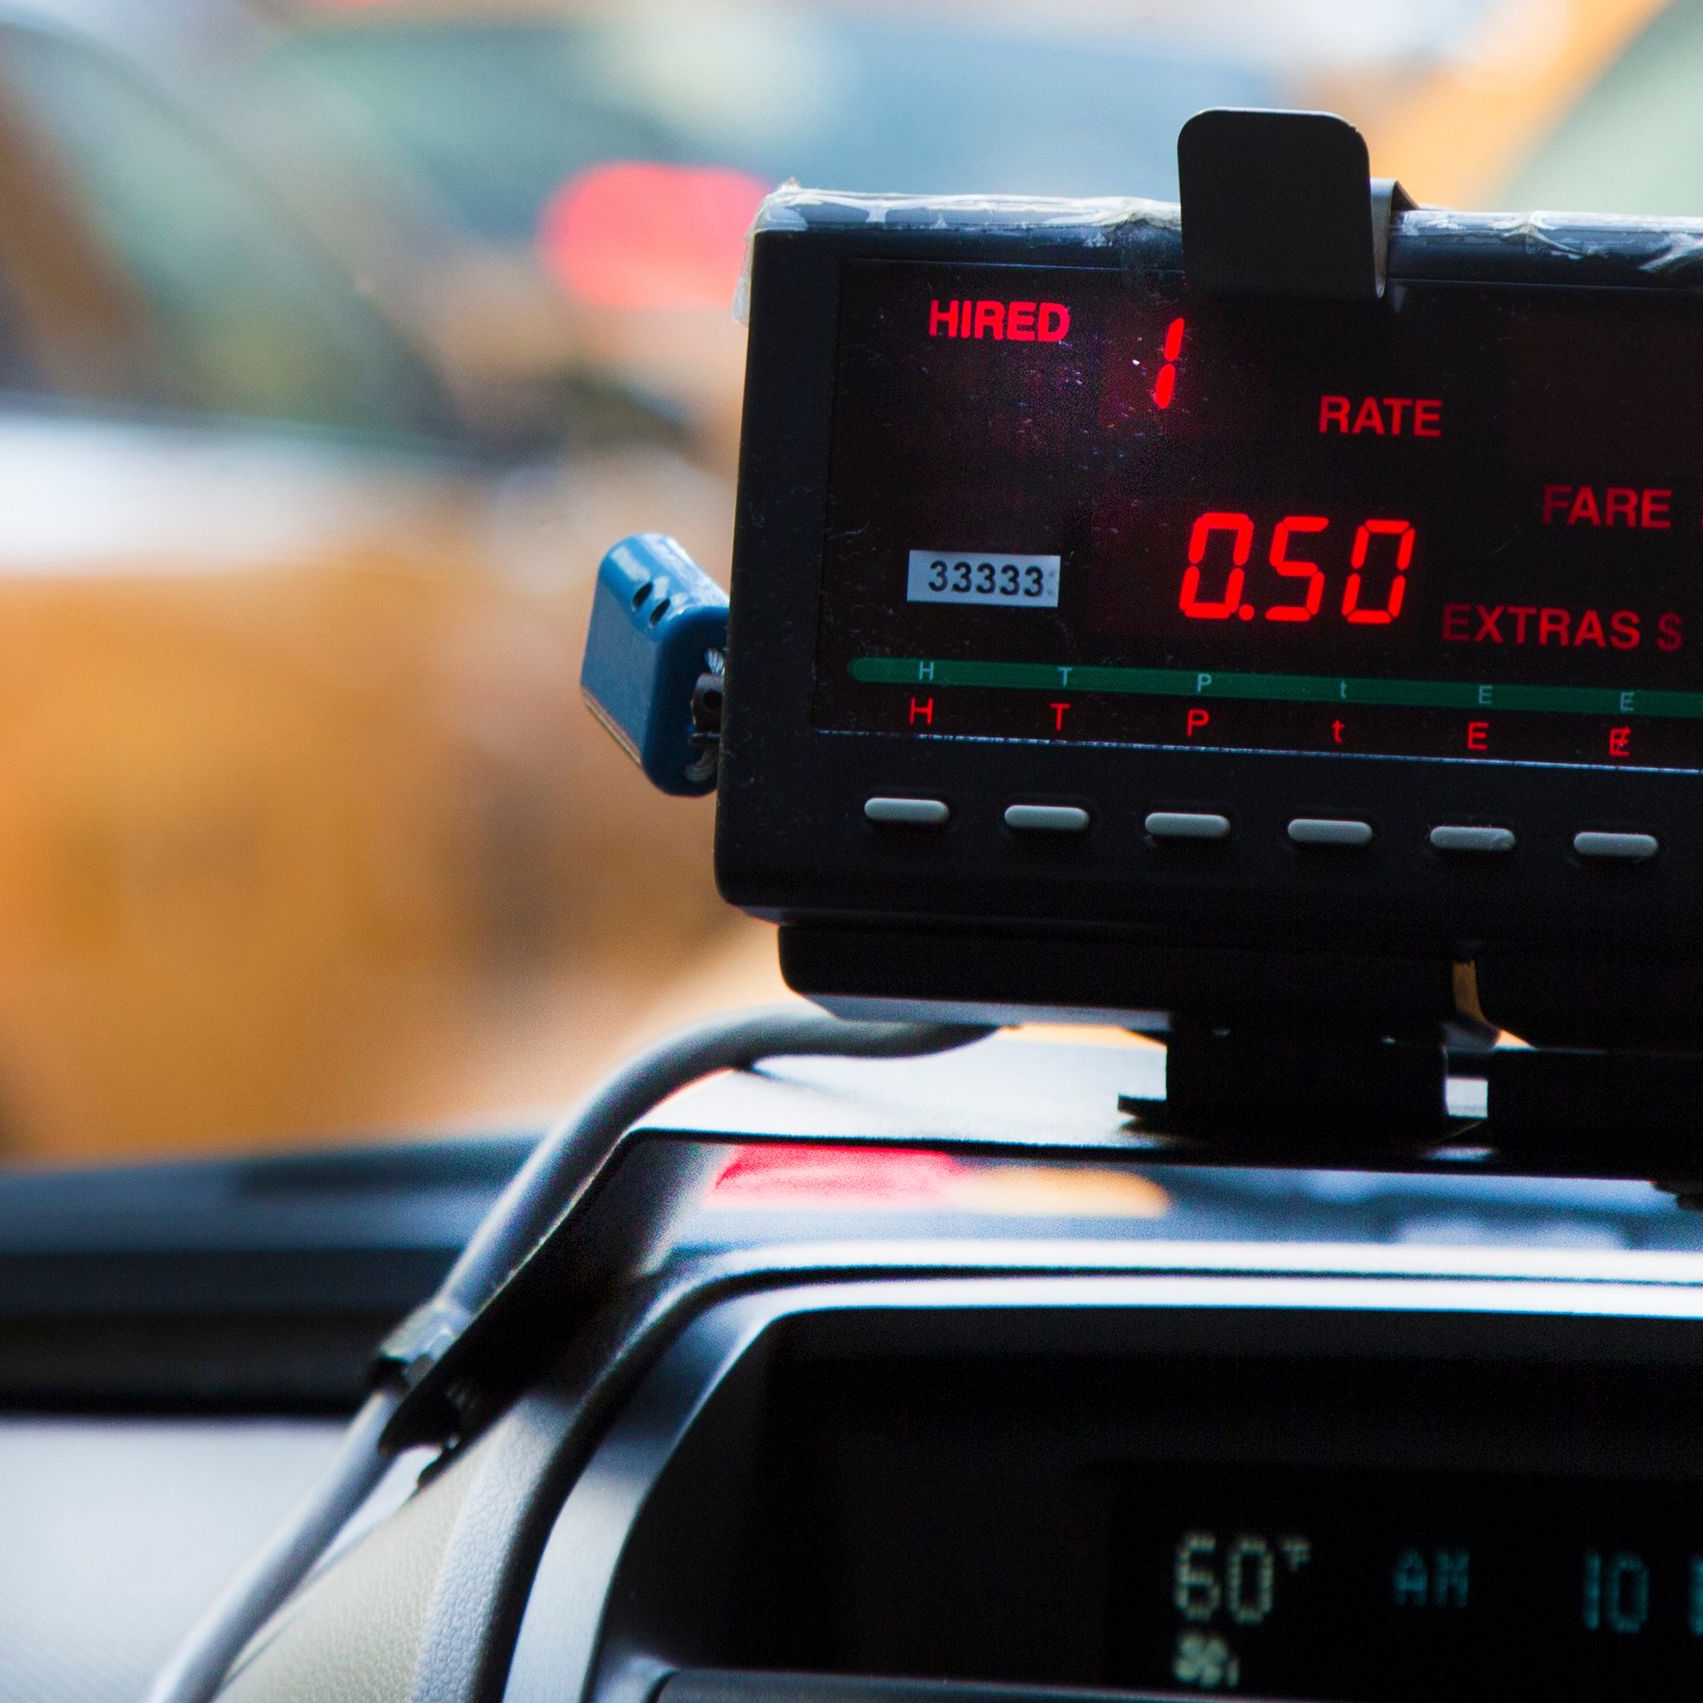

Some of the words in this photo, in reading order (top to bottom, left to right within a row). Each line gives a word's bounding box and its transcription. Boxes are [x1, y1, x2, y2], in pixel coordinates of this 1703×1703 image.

[929, 299, 1071, 343] HIRED
[1153, 317, 1185, 410] 1
[1319, 395, 1442, 438] RATE
[1543, 484, 1672, 530] FARE
[928, 560, 1044, 598] 33333
[1177, 510, 1416, 626] 0.50
[1442, 603, 1641, 650] EXTRAS
[1656, 611, 1683, 652] $
[919, 661, 934, 681] H
[1058, 667, 1072, 686] T
[1197, 673, 1212, 692] P
[1339, 680, 1348, 698] t
[1478, 685, 1494, 704] E
[909, 697, 934, 725] H
[1049, 702, 1071, 731] T
[1186, 708, 1210, 737] P
[1331, 719, 1345, 744] t
[1467, 721, 1490, 750] E
[1393, 1550, 1469, 1607] AM
